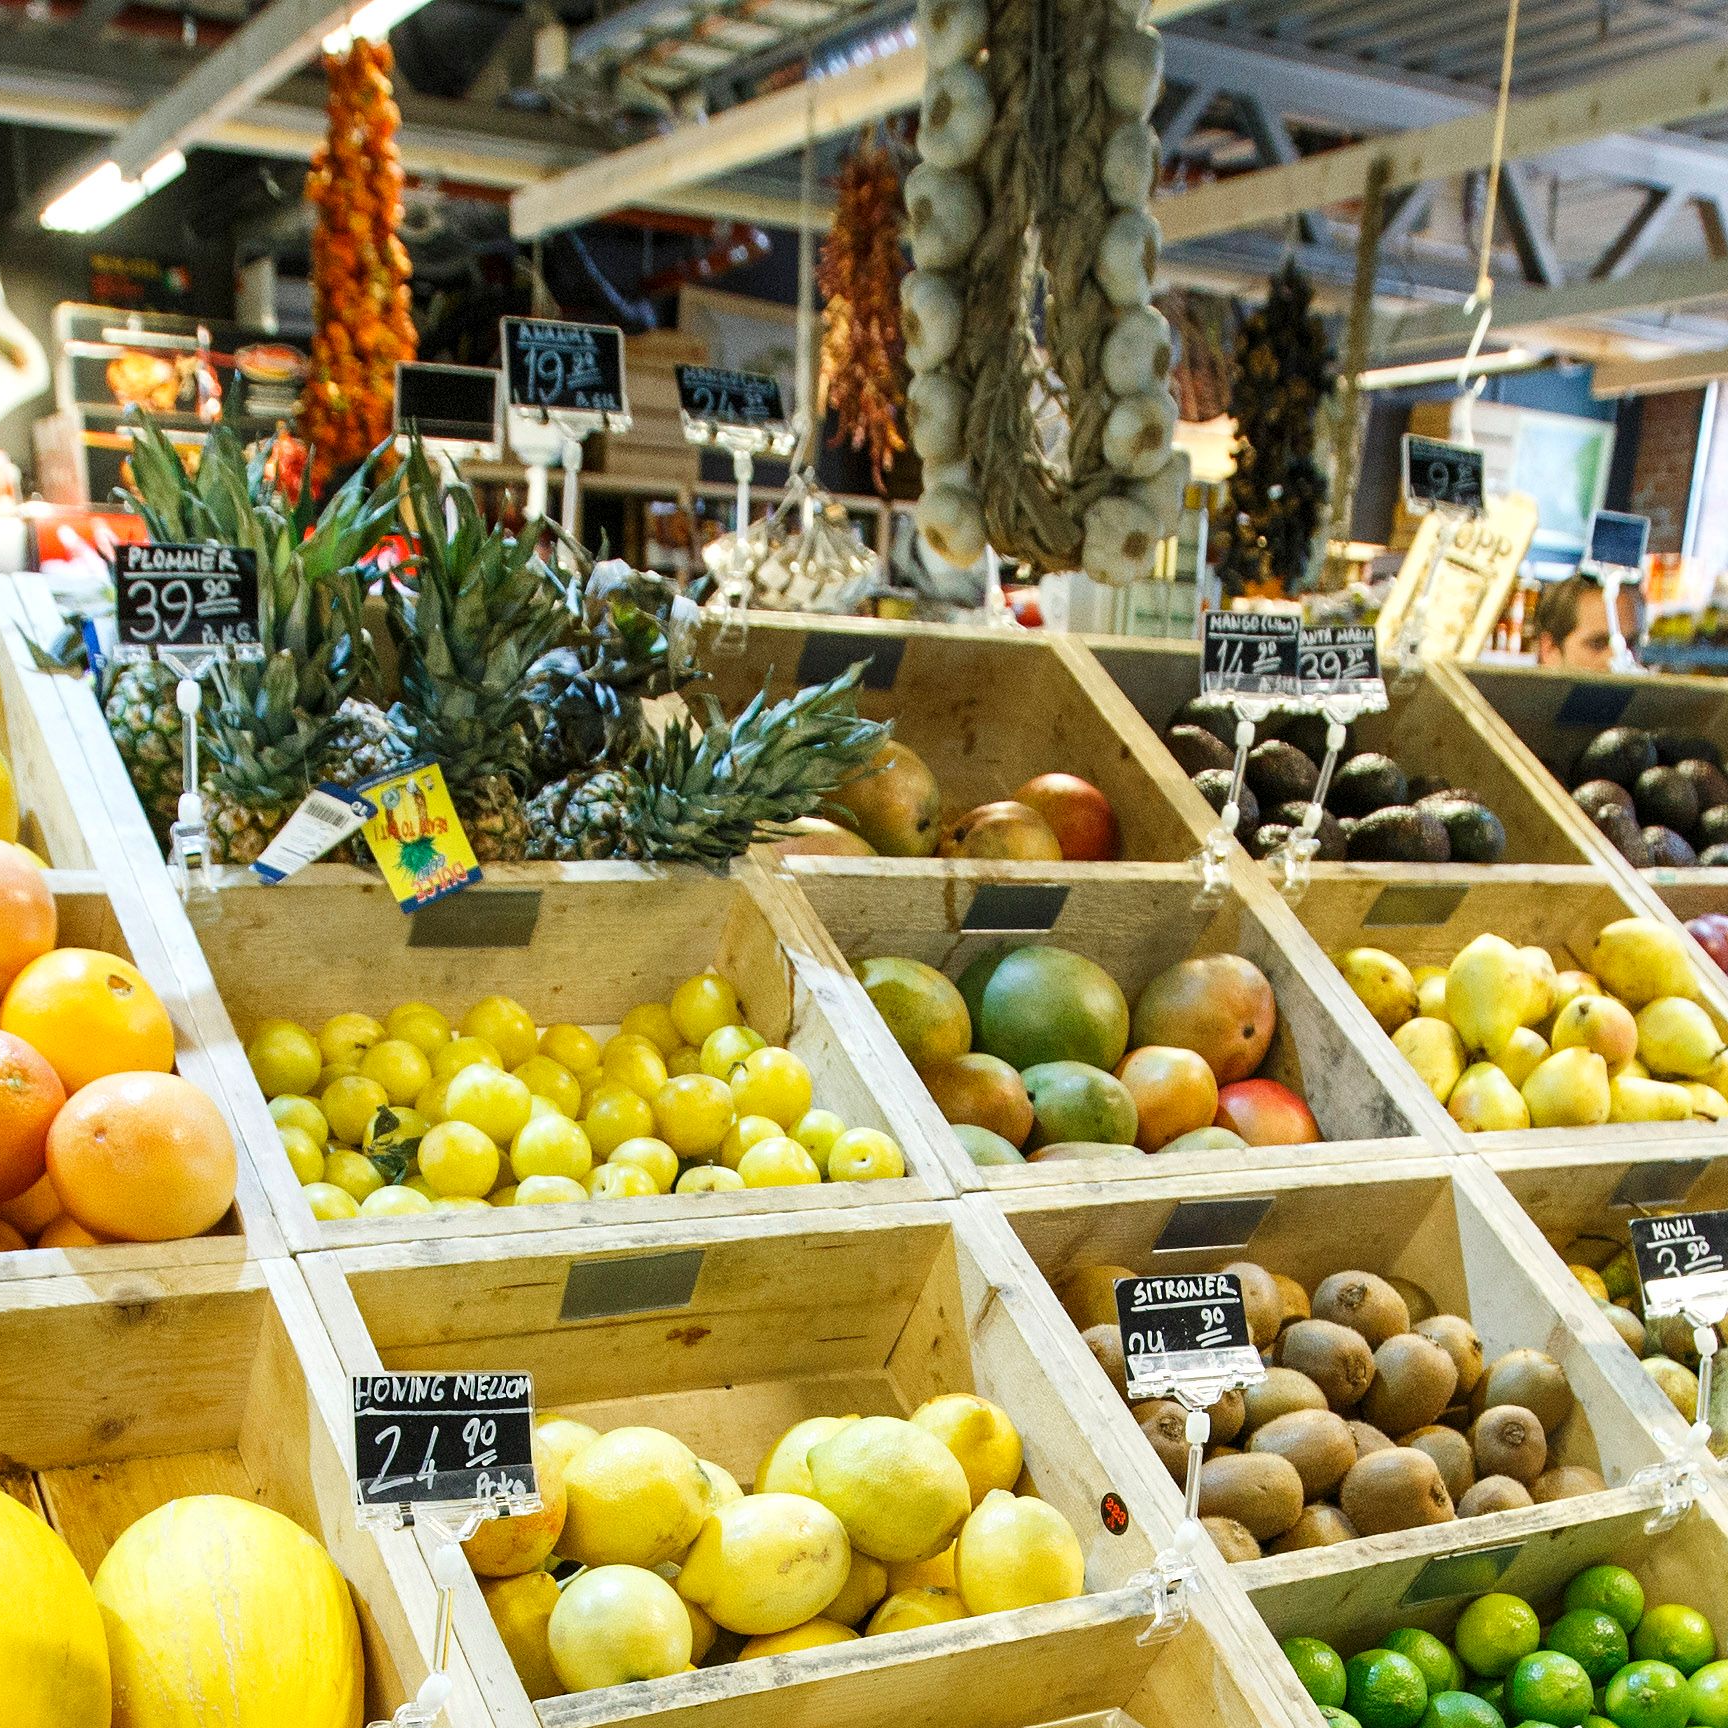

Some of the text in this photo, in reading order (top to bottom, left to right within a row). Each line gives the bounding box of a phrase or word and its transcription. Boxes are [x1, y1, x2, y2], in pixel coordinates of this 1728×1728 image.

[523, 348, 564, 404] 19
[128, 546, 239, 571] PLOMMER
[128, 579, 232, 641] 39 90
[1300, 627, 1333, 646] ANTA
[412, 862, 468, 902] DULCE
[1651, 1218, 1696, 1241] KIWI
[1687, 1240, 1711, 1262] 90
[1133, 1275, 1238, 1306] SITRONER
[1200, 1306, 1226, 1331] 90
[355, 1374, 532, 1410] HONING MELLON
[368, 1417, 498, 1495] 24 90
